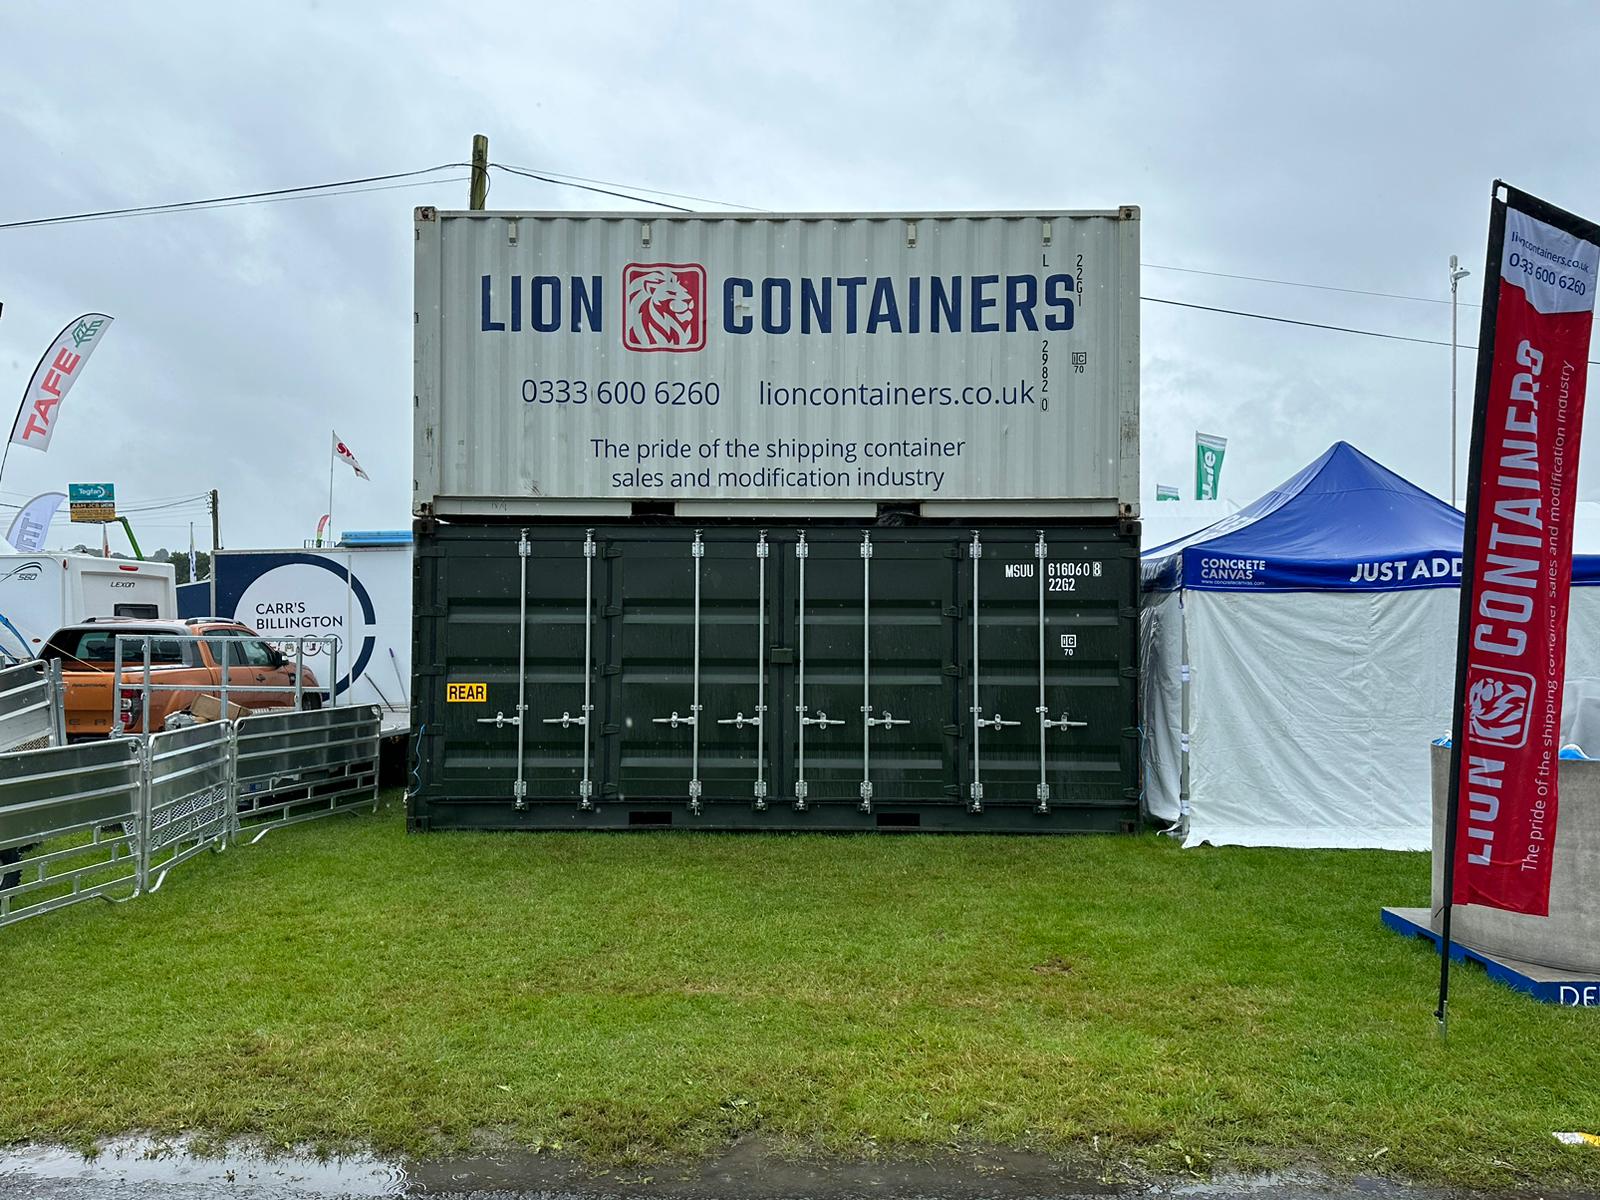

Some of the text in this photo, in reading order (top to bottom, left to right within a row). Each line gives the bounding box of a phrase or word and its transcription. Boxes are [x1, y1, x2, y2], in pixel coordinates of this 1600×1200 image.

[1535, 267, 1556, 286] 600
[1559, 275, 1586, 296] 6260
[481, 273, 1075, 335] LION CONTAINERS
[22, 347, 81, 440] TAFE
[521, 379, 1035, 406] 0333 600 6260 lioncontainers.co.uk
[1556, 360, 1575, 424] industry
[590, 438, 966, 464] The pride of the shipping container
[612, 467, 945, 491] sales and modification industry
[1548, 427, 1567, 522] modification
[1547, 526, 1559, 556] and
[1005, 564, 1034, 578] MSUU
[1201, 558, 1266, 570] CONCRETE
[1201, 569, 1253, 580] CANVAS
[1349, 561, 1408, 583] JUST
[1048, 578, 1076, 592] 22G2
[1548, 560, 1558, 598] sales
[255, 602, 306, 615] CARR'S
[256, 615, 343, 630] BILLINGTON
[449, 685, 485, 700] REAR
[1542, 680, 1558, 746] shipping
[1537, 752, 1552, 776] the
[1535, 778, 1548, 796] of
[1528, 799, 1547, 841] pride
[1521, 844, 1541, 872] The
